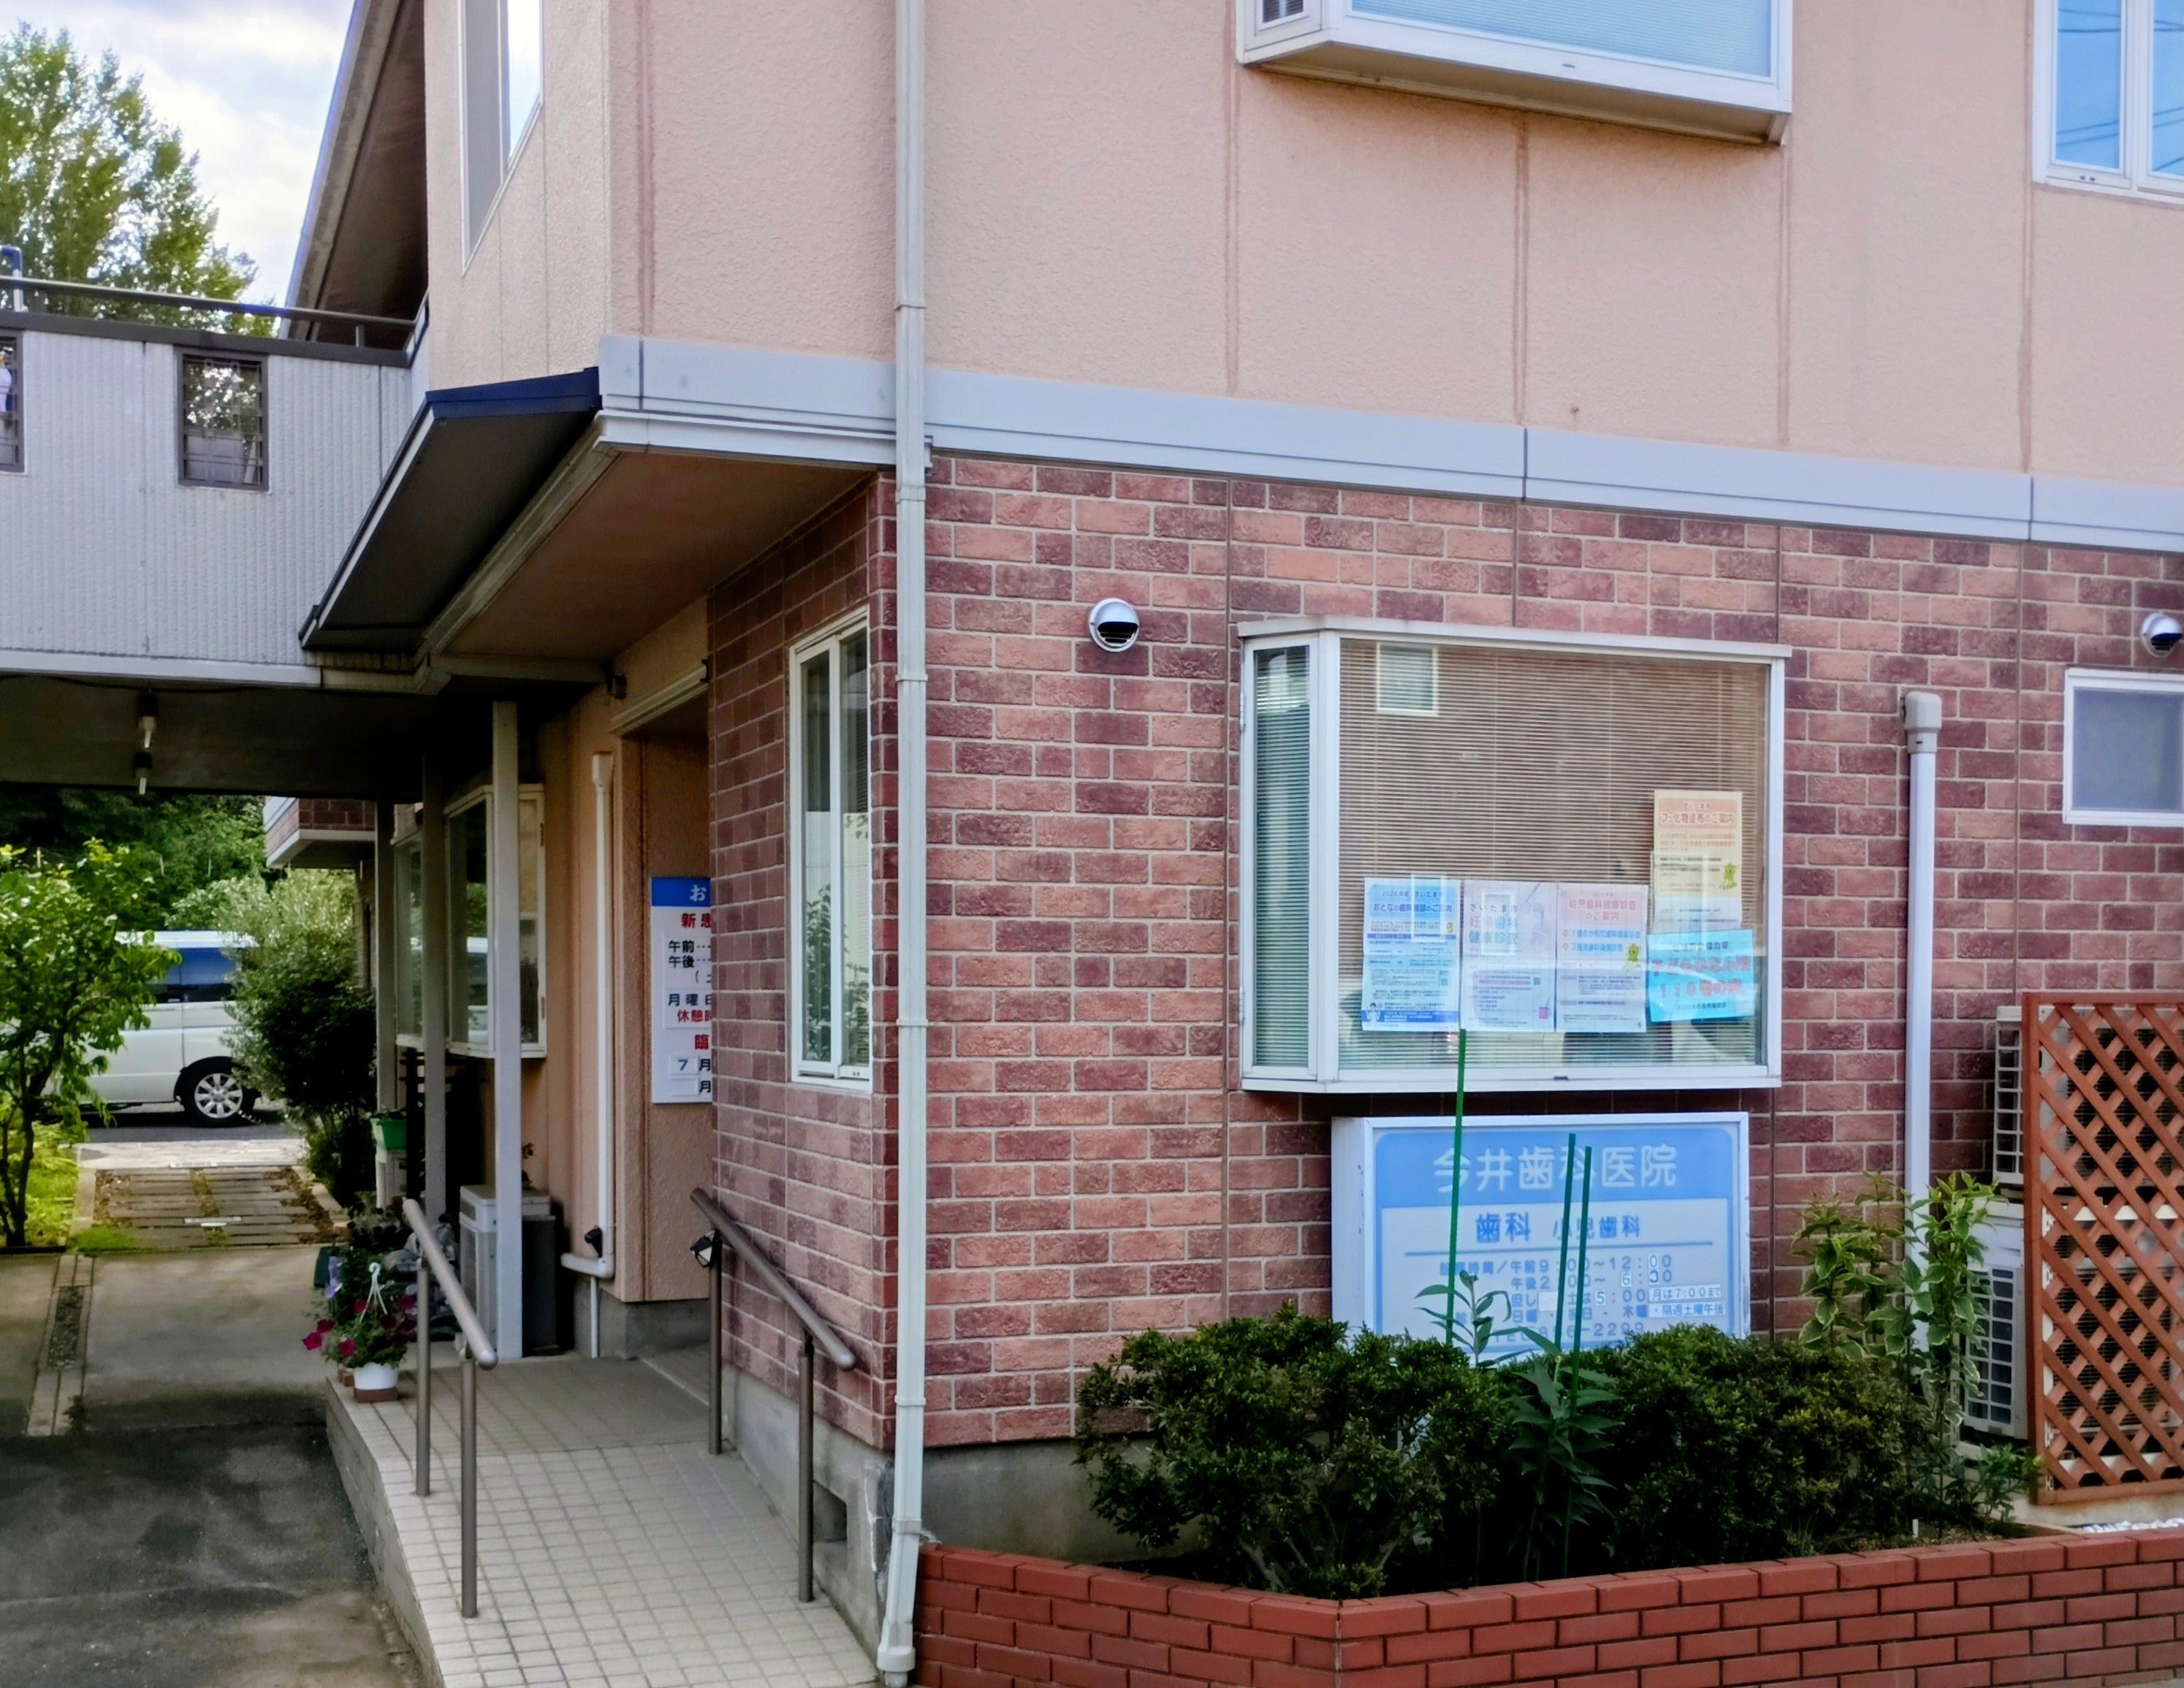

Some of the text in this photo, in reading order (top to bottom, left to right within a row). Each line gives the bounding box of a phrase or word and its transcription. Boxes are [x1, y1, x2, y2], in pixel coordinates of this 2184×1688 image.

[689, 884, 707, 902] お
[1433, 1143, 1678, 1193] 今井歯科医院
[1475, 1211, 1532, 1244] 歯科
